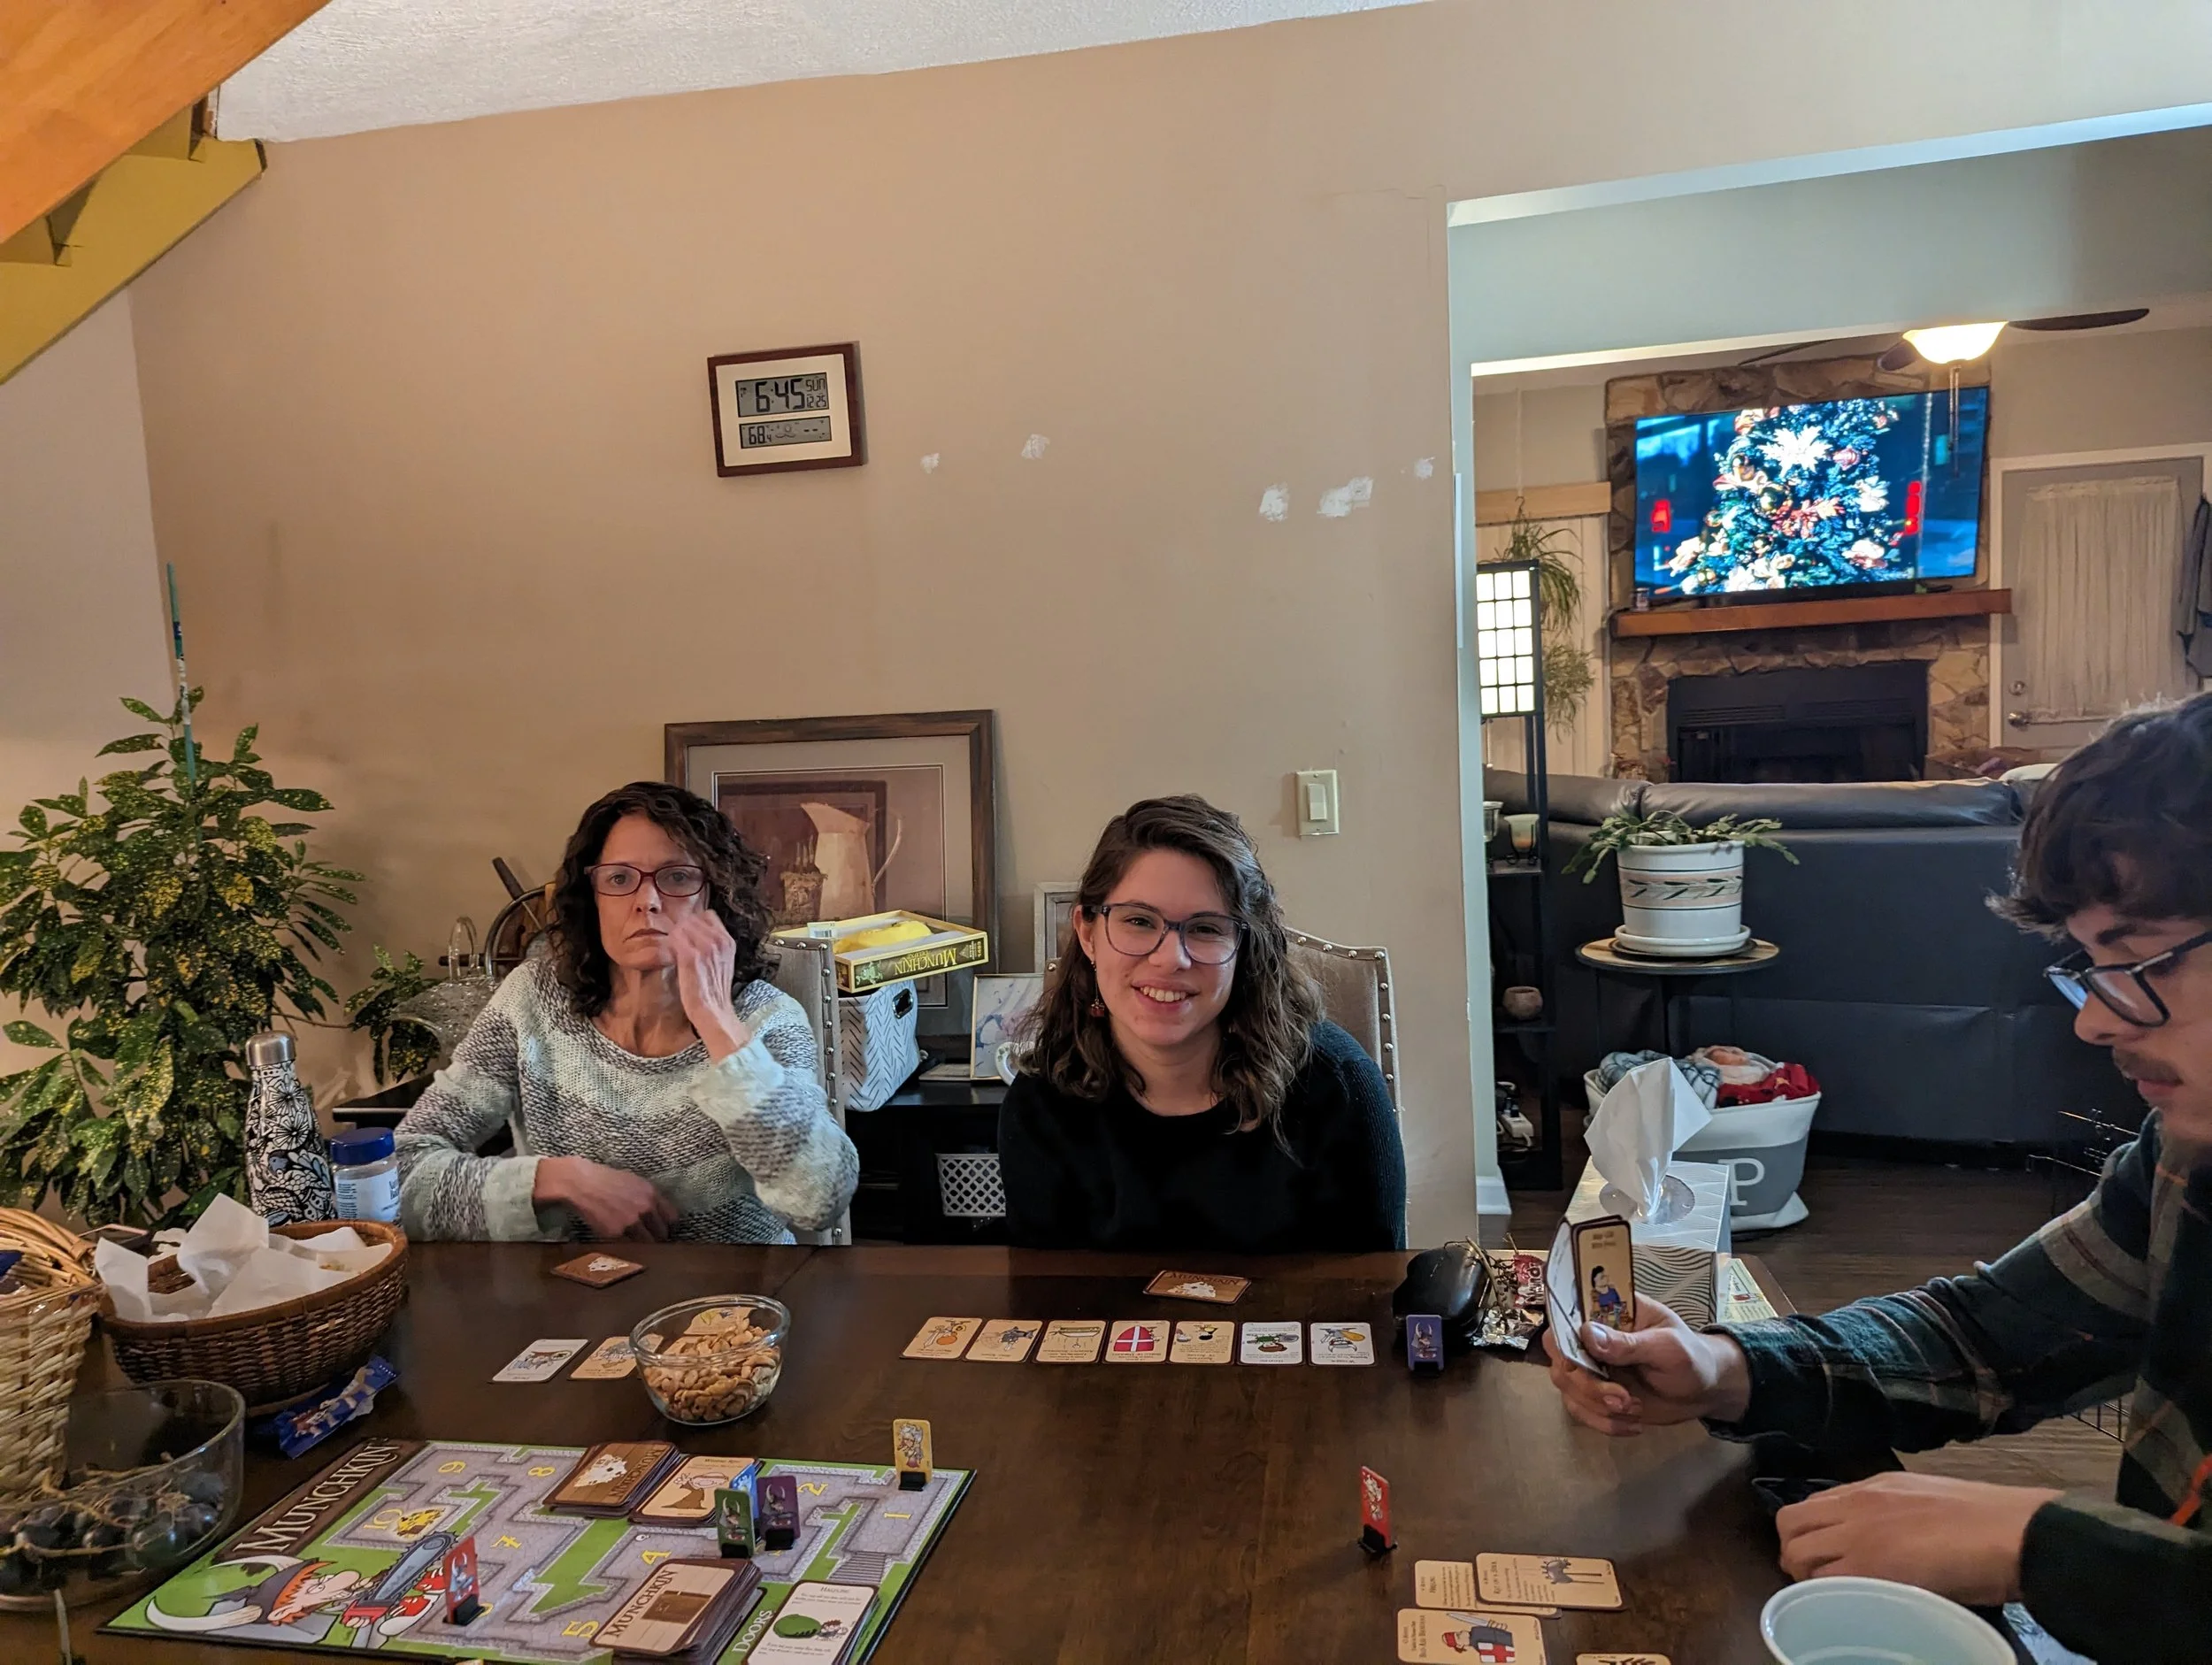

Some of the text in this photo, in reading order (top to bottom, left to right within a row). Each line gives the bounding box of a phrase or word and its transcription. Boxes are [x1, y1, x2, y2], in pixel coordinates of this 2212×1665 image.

[755, 378, 805, 412] 6:45
[806, 378, 826, 392] SUN
[806, 395, 826, 408] 12 25
[895, 948, 956, 975] MUNCHKIN
[1717, 1157, 1765, 1207] P
[527, 1466, 556, 1477] 8
[233, 1445, 400, 1552] MUNCHKIN
[797, 1481, 829, 1497] 2
[363, 1508, 404, 1530] 10
[641, 1549, 672, 1565] 4
[604, 1569, 678, 1638] MUNCHKIN
[562, 1620, 600, 1638] 5
[732, 1609, 774, 1653] DOORS
